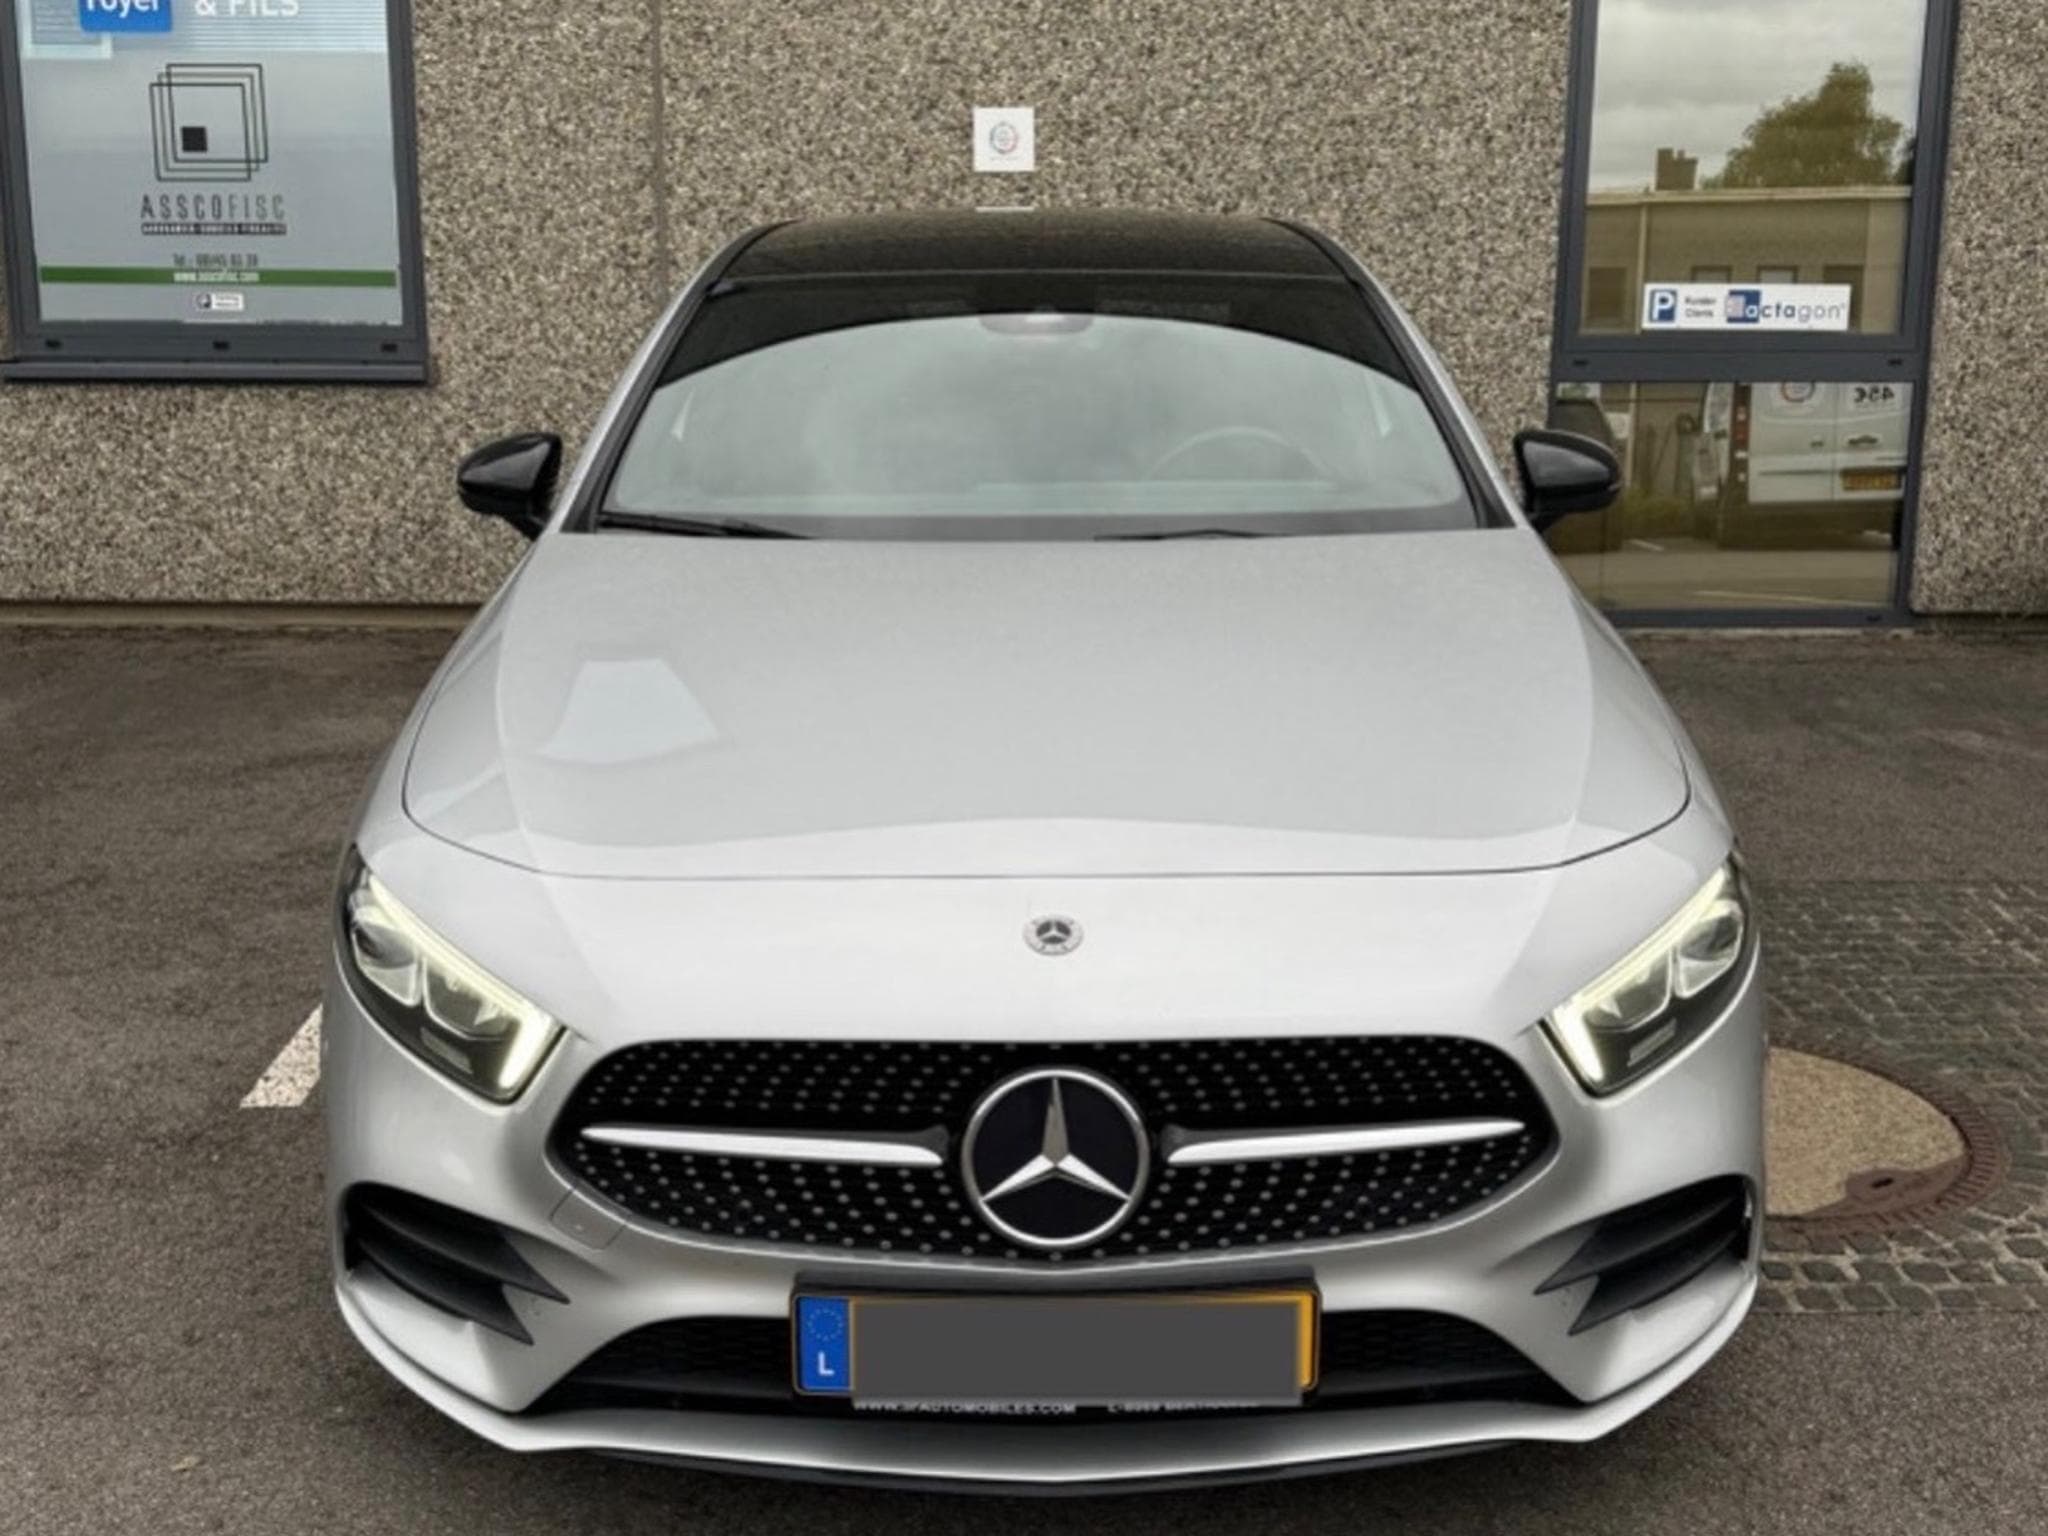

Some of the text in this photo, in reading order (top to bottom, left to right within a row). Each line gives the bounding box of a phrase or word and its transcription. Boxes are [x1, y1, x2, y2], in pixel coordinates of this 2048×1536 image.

[195, 0, 299, 16] & FILS
[140, 194, 285, 220] ASSCOFISC
[1651, 291, 1675, 320] P
[818, 1351, 835, 1376] L
